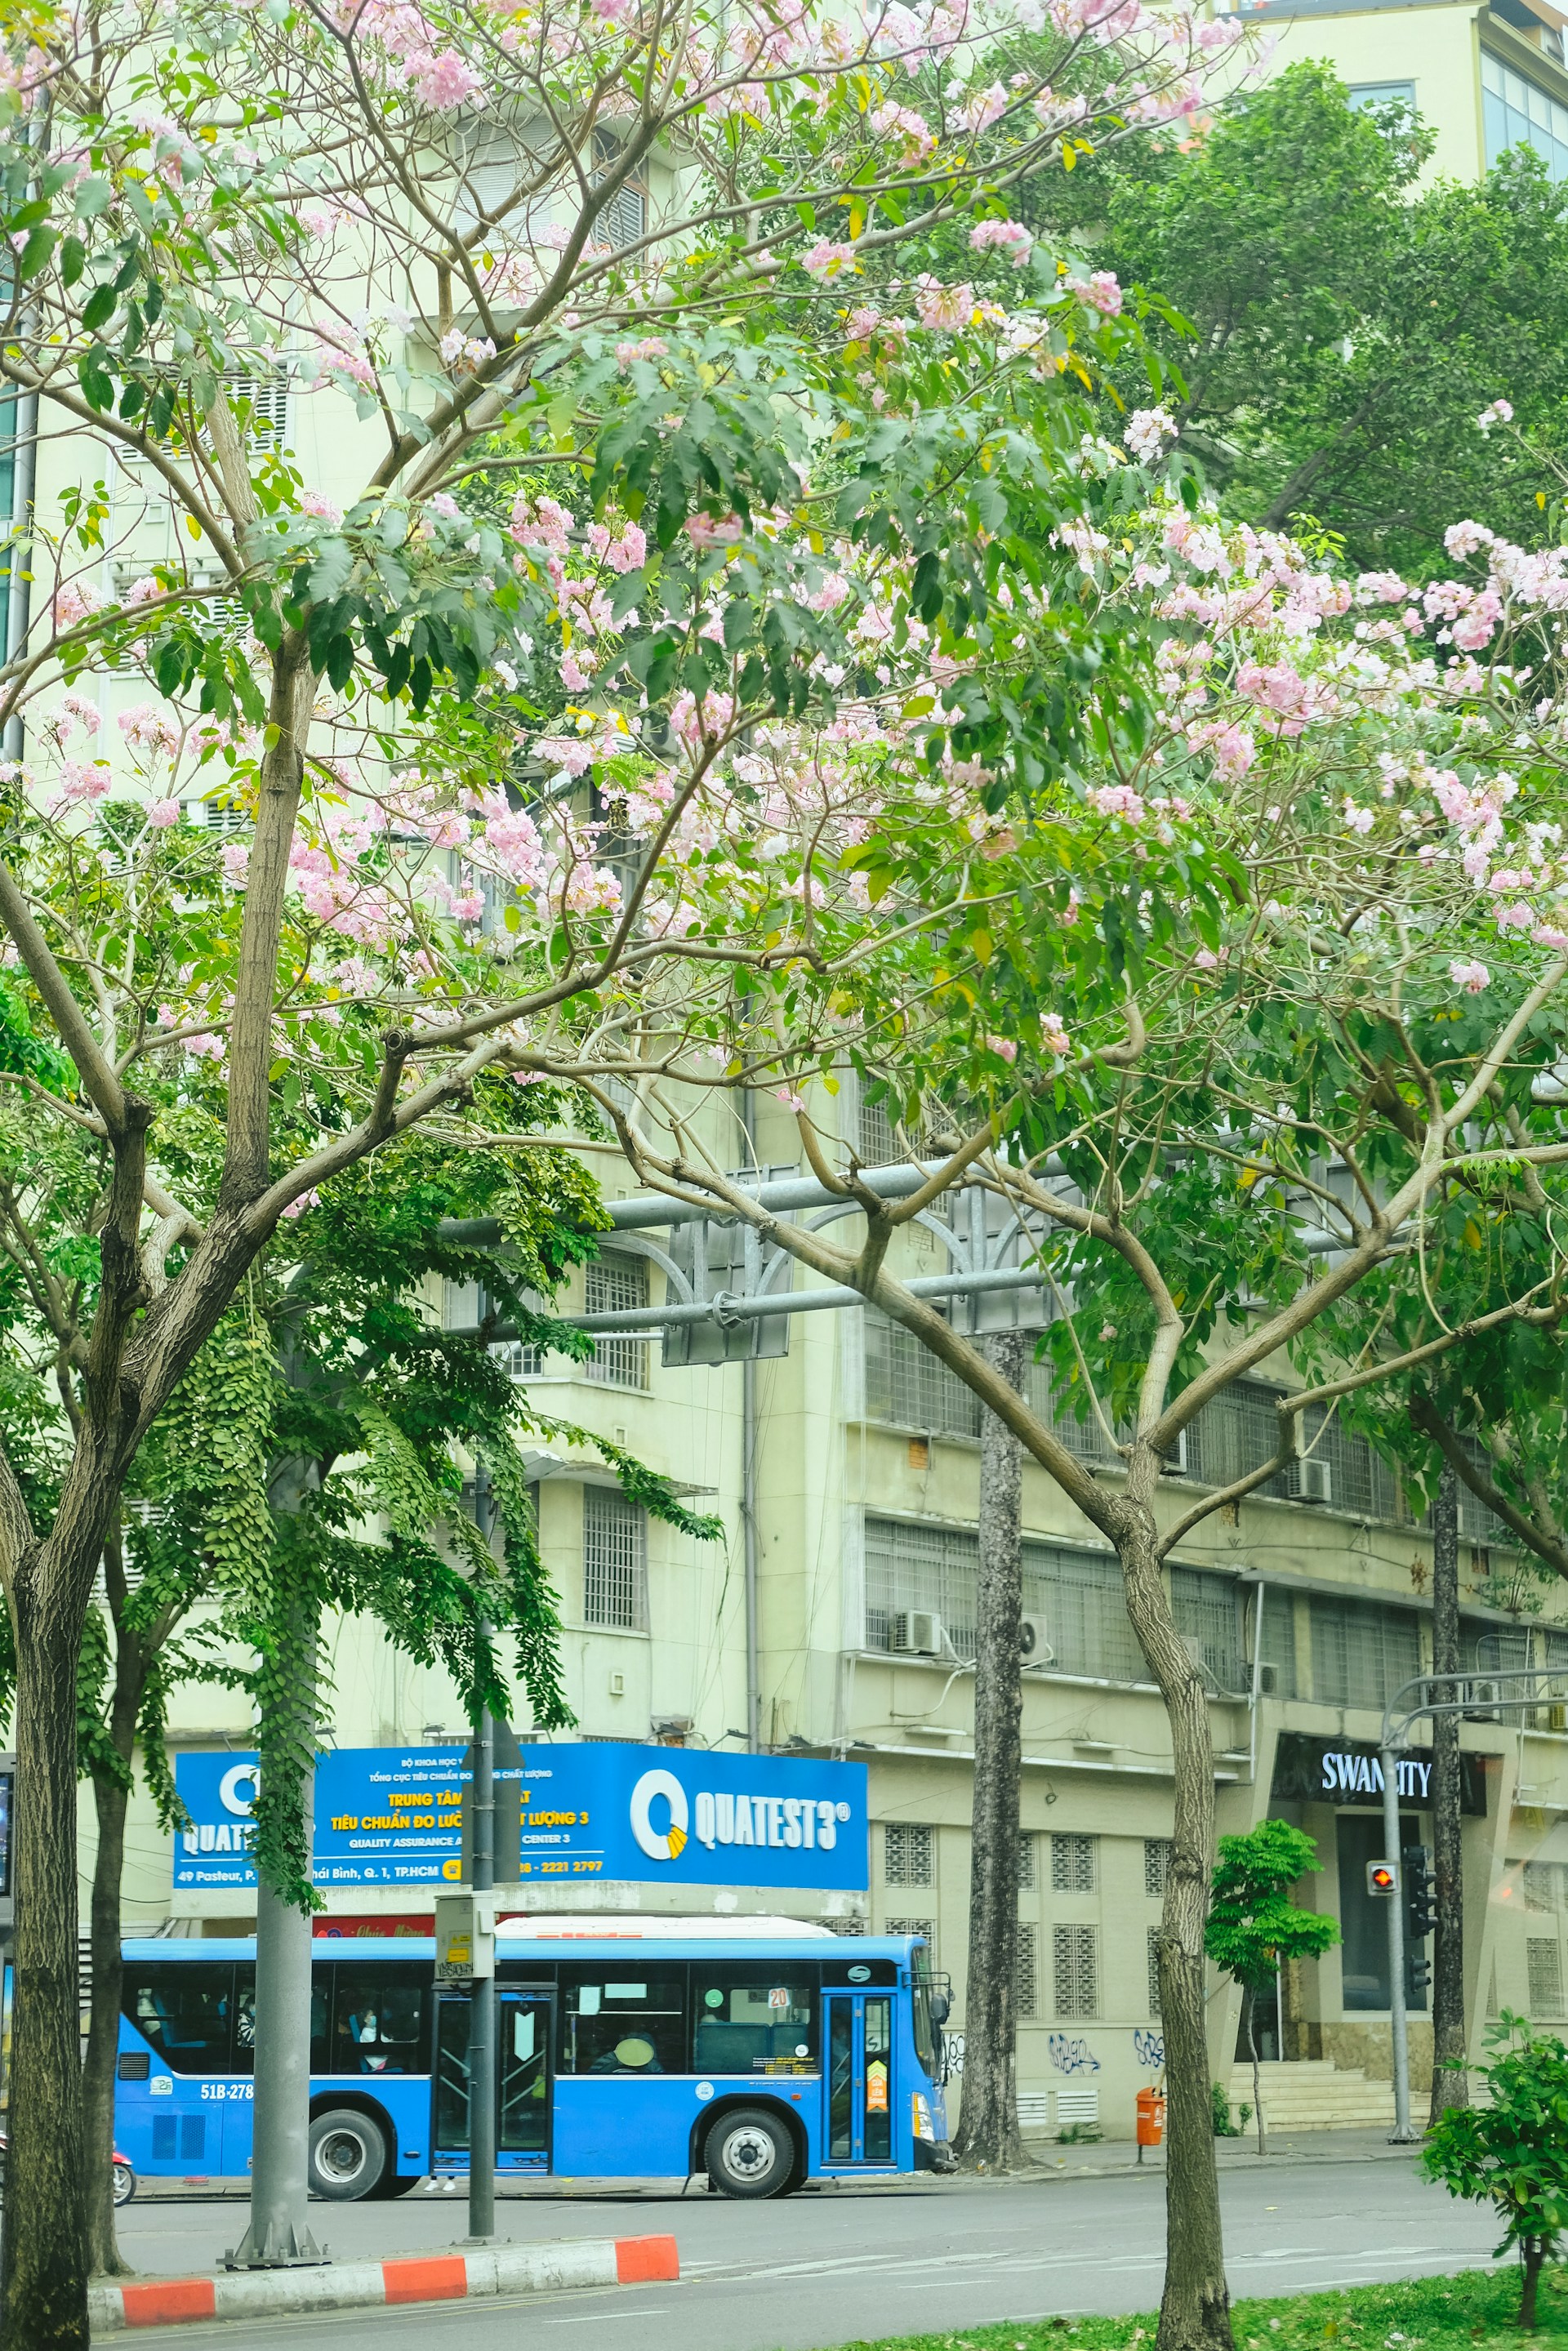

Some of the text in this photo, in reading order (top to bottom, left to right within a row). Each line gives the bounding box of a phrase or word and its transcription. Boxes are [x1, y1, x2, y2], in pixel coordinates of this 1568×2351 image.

[415, 1758, 438, 1767] KHOA
[439, 1757, 457, 1768] HỌC
[393, 1774, 412, 1783] CỤC
[1322, 1752, 1432, 1798] SWANITY
[388, 1792, 434, 1807] TRUNG
[331, 1814, 359, 1831] TIÊU
[361, 1808, 411, 1830] CHUẨN
[413, 1814, 435, 1828] ĐO
[528, 1810, 577, 1828] LƯỢNG
[579, 1811, 589, 1825] 3
[349, 1838, 392, 1849] QUALITY
[393, 1837, 454, 1848] ASSURANCE
[521, 1834, 562, 1845] CENTER
[562, 1834, 571, 1843] 3
[177, 1871, 194, 1882] 49
[195, 1870, 243, 1883] Pasteur,
[245, 1869, 256, 1881] P.
[332, 1865, 362, 1881] Bình,
[363, 1867, 379, 1879] Q.
[381, 1868, 391, 1880] 1,
[394, 1865, 439, 1877] TP.HCM
[541, 1861, 569, 1873] 2221
[572, 1860, 604, 1872] 2797
[770, 1988, 786, 2007] 20
